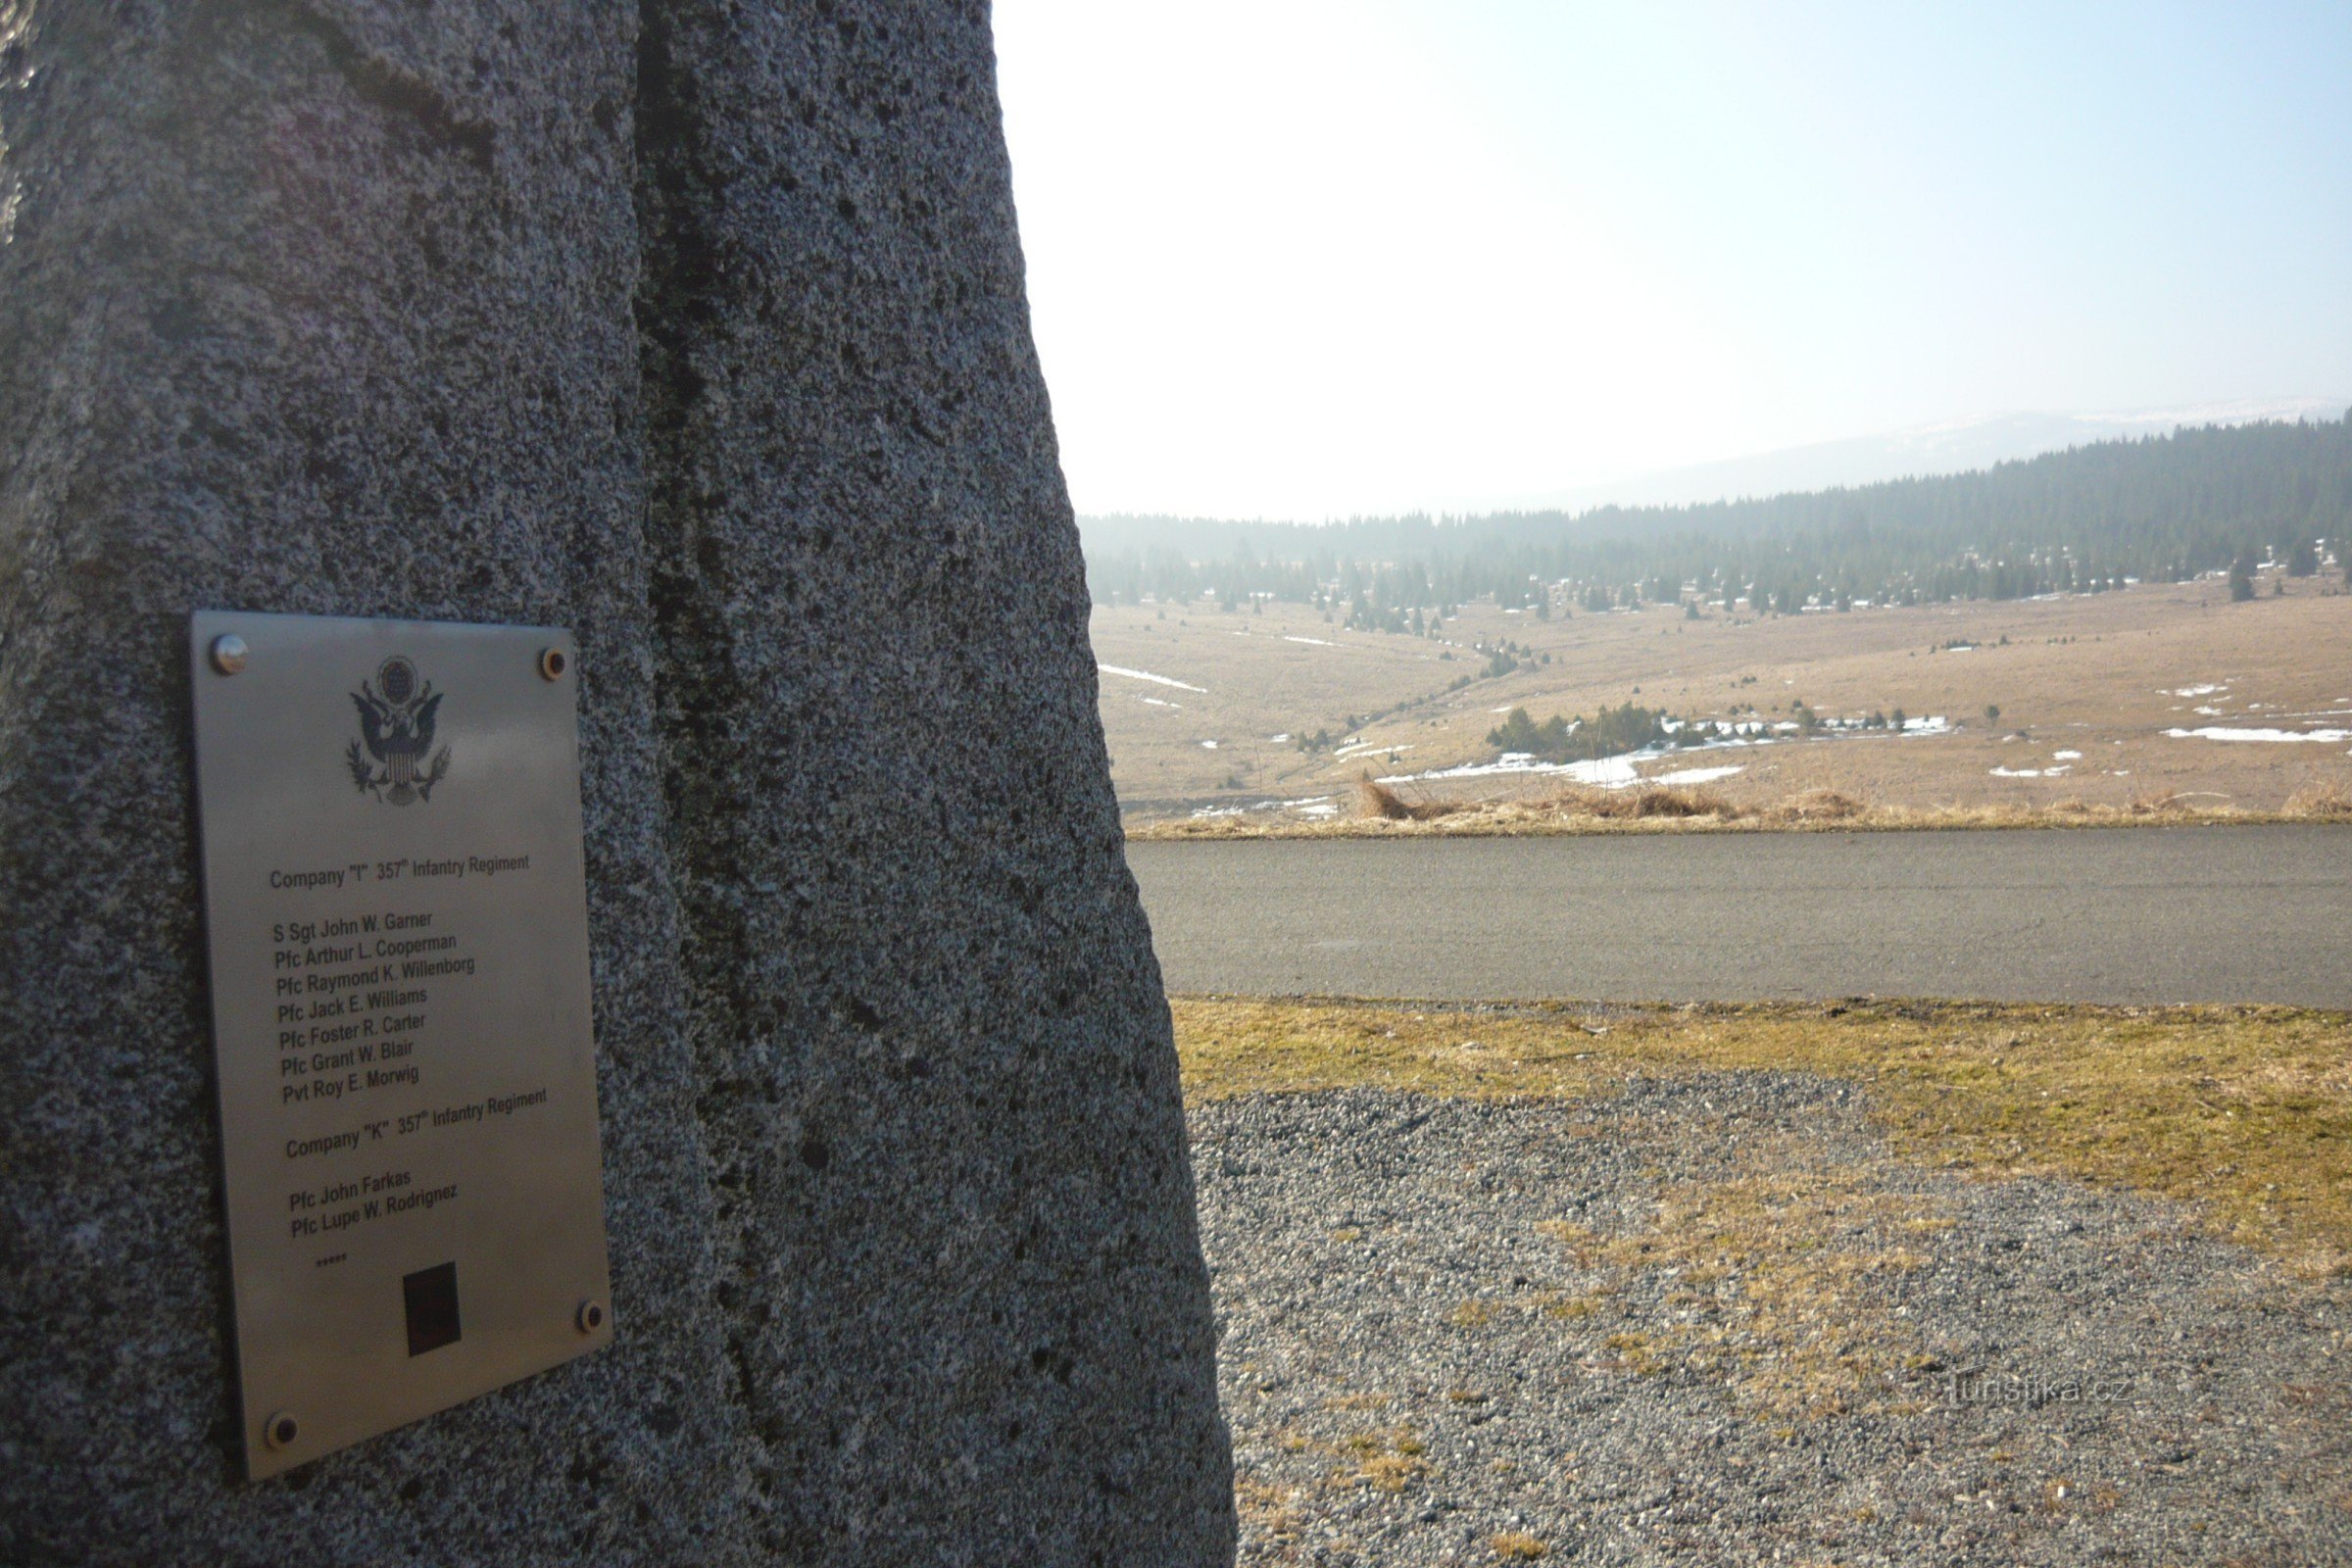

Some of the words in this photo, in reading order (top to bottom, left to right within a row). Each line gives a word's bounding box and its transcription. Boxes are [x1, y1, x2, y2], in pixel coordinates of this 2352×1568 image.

[270, 868, 345, 890] Company
[414, 858, 465, 878] Infantry
[469, 855, 530, 876] Regiment
[273, 923, 283, 943] S
[290, 923, 316, 943] Sgt
[321, 918, 358, 937] John
[364, 915, 379, 933] W.
[275, 951, 301, 969] Pfc
[306, 945, 354, 965] Arthur
[360, 943, 371, 959] L.
[377, 935, 457, 958] Cooperman
[277, 977, 302, 997] Pfc
[308, 966, 378, 994] Raymond
[384, 965, 399, 982] K.
[403, 957, 475, 979] Willenborg
[278, 1004, 304, 1023] Pfc
[309, 998, 345, 1019] Jack
[350, 995, 364, 1012] E.
[368, 987, 427, 1009] Williams
[280, 1031, 306, 1050] Pfc
[311, 1021, 359, 1045] Foster
[365, 1018, 378, 1036] R.
[383, 1012, 425, 1034] Carter
[282, 1057, 307, 1077] Pfc
[313, 1048, 355, 1071] Grant
[360, 1045, 376, 1062] W.
[381, 1040, 414, 1060] Blair
[283, 1085, 309, 1103] Pvt
[315, 1078, 343, 1099] Roy
[349, 1074, 364, 1092] E.
[368, 1064, 419, 1089] Morwig
[286, 1131, 360, 1158] Company
[365, 1121, 389, 1140] "K"
[433, 1102, 483, 1127] Infantry
[488, 1088, 547, 1115] Regiment
[290, 1191, 316, 1211] Pfc
[321, 1180, 358, 1205] John
[364, 1169, 411, 1194] Farkas
[292, 1217, 318, 1238] Pfc
[322, 1204, 361, 1232] Lupe
[365, 1201, 382, 1220] W.
